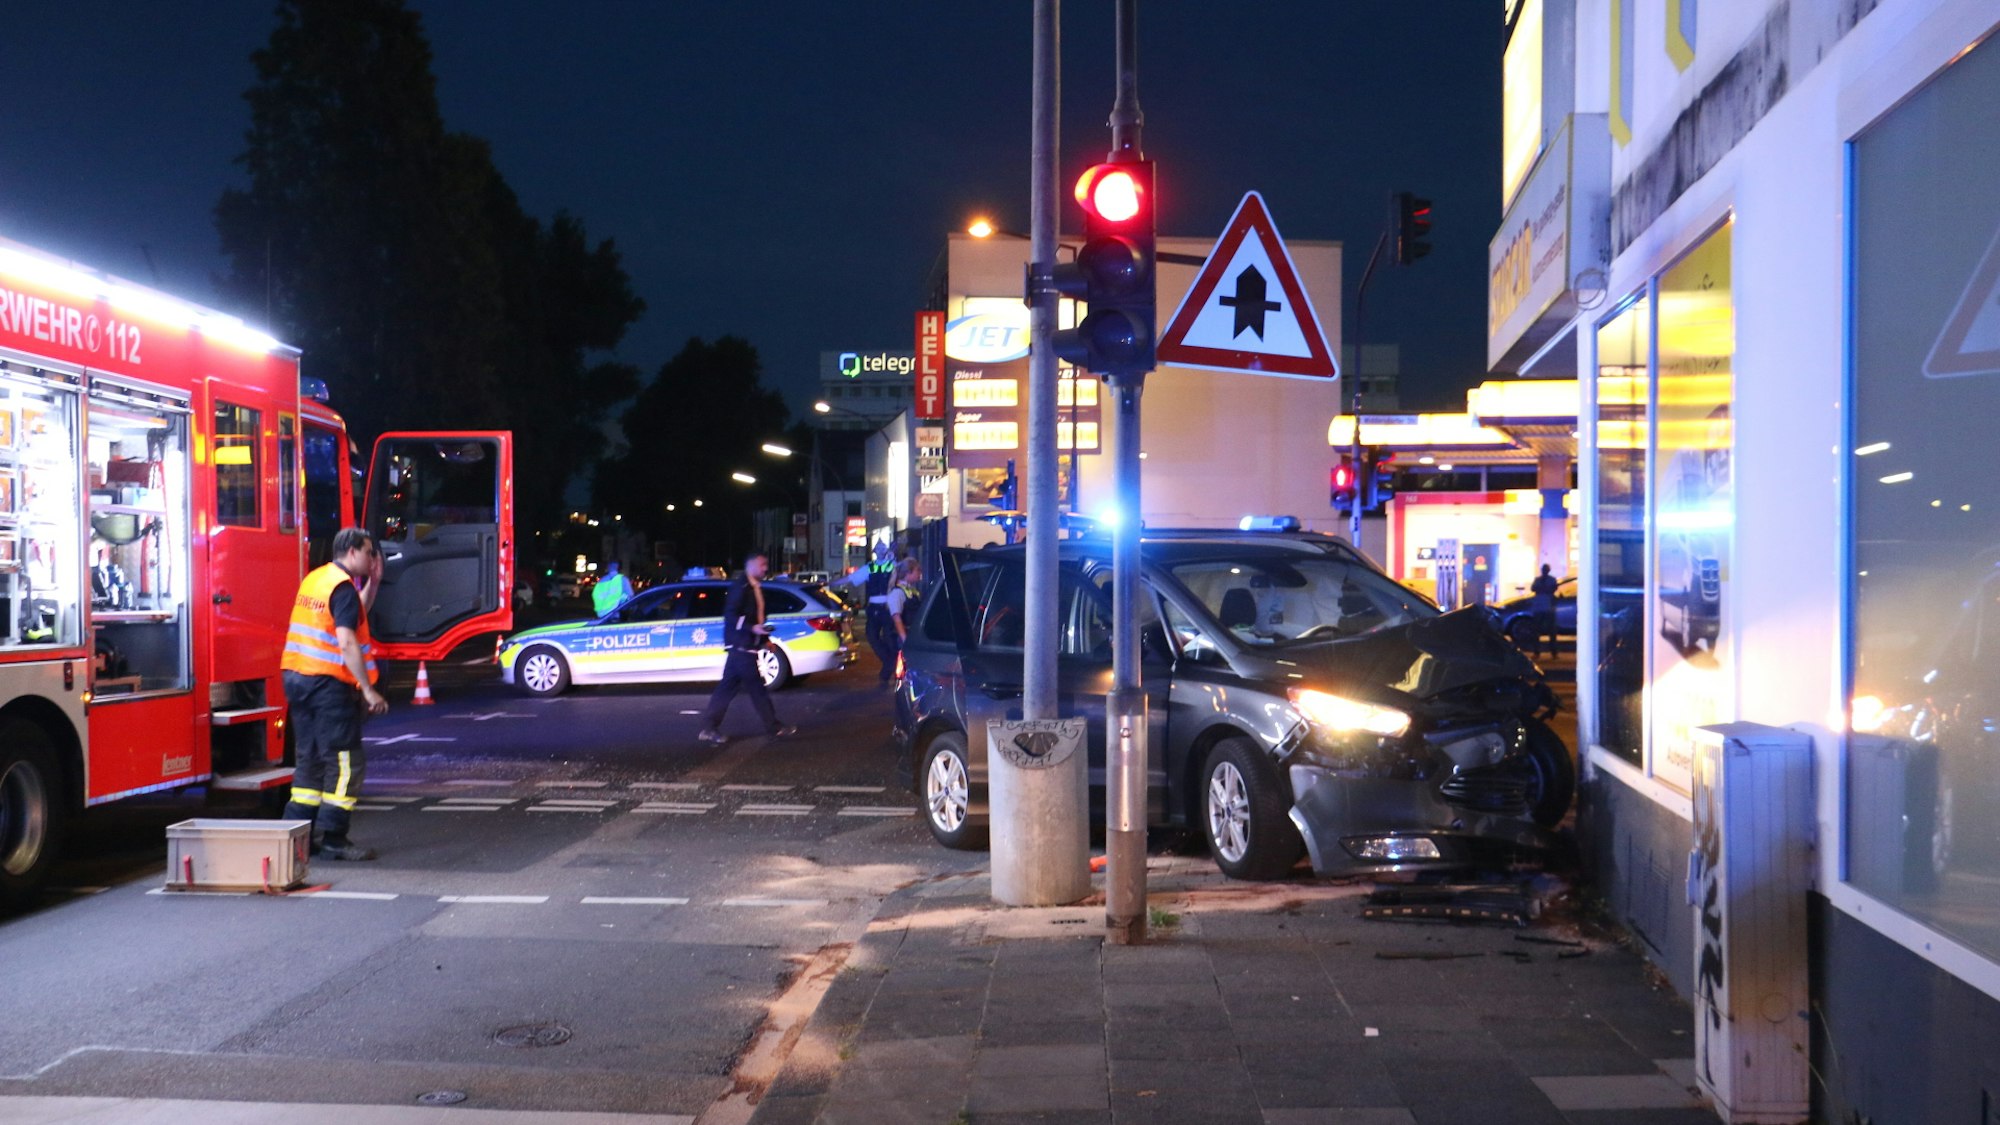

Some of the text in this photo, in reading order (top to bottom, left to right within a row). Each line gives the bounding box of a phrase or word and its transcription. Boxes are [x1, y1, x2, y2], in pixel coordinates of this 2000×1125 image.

[105, 319, 141, 364] 112
[959, 326, 1020, 348] JET
[922, 315, 937, 415] HELOT
[954, 370, 983, 379] Diesel
[955, 412, 982, 423] Super
[593, 633, 650, 649] POLIZEI
